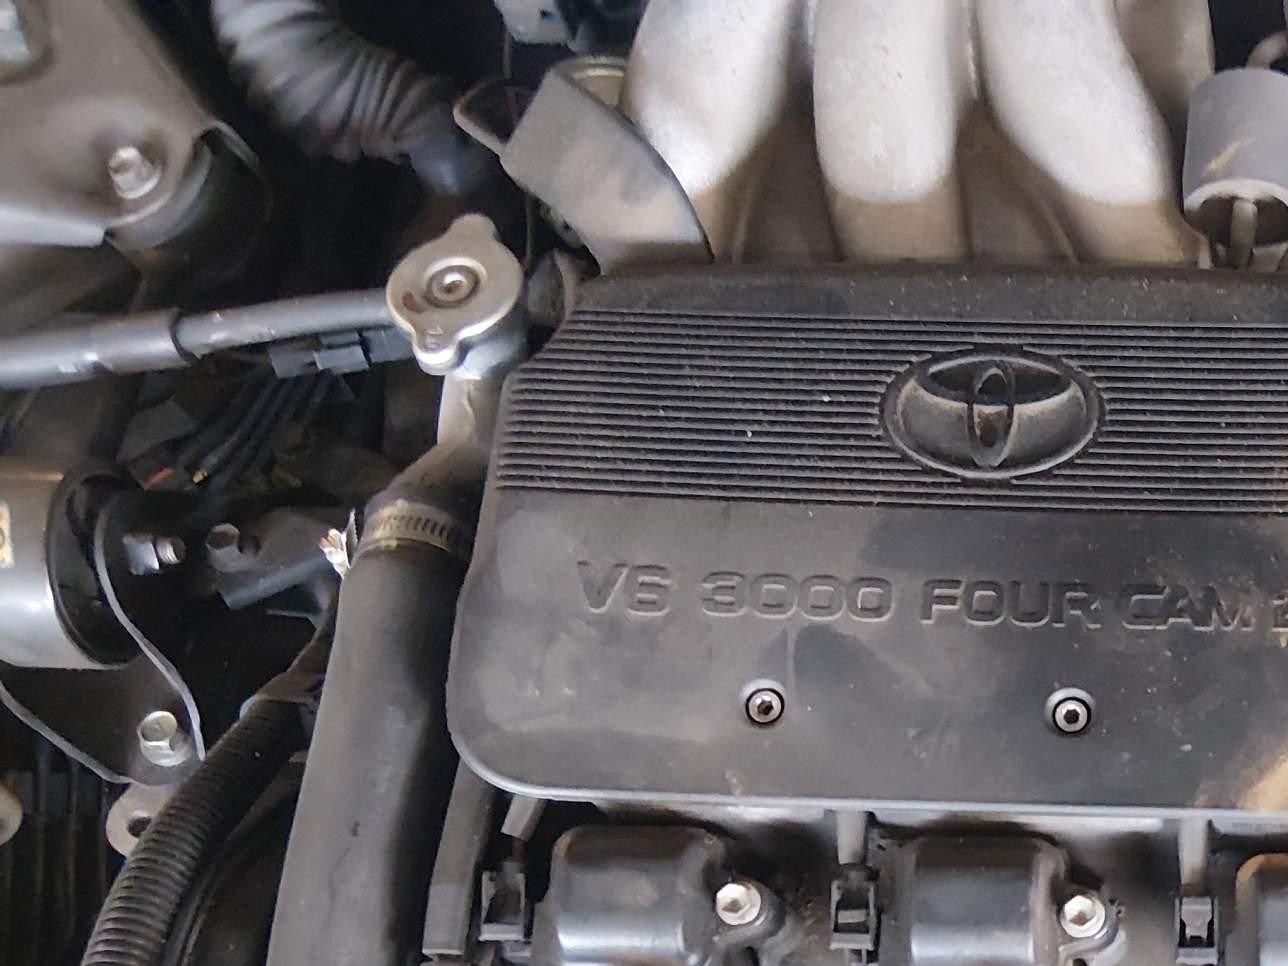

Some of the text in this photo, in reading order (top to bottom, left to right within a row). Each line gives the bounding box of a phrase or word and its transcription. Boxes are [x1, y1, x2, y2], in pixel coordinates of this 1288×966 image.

[576, 560, 671, 616] V6
[701, 571, 894, 622] 3000
[921, 579, 1103, 630] FOUR
[1120, 582, 1255, 633] CAM
